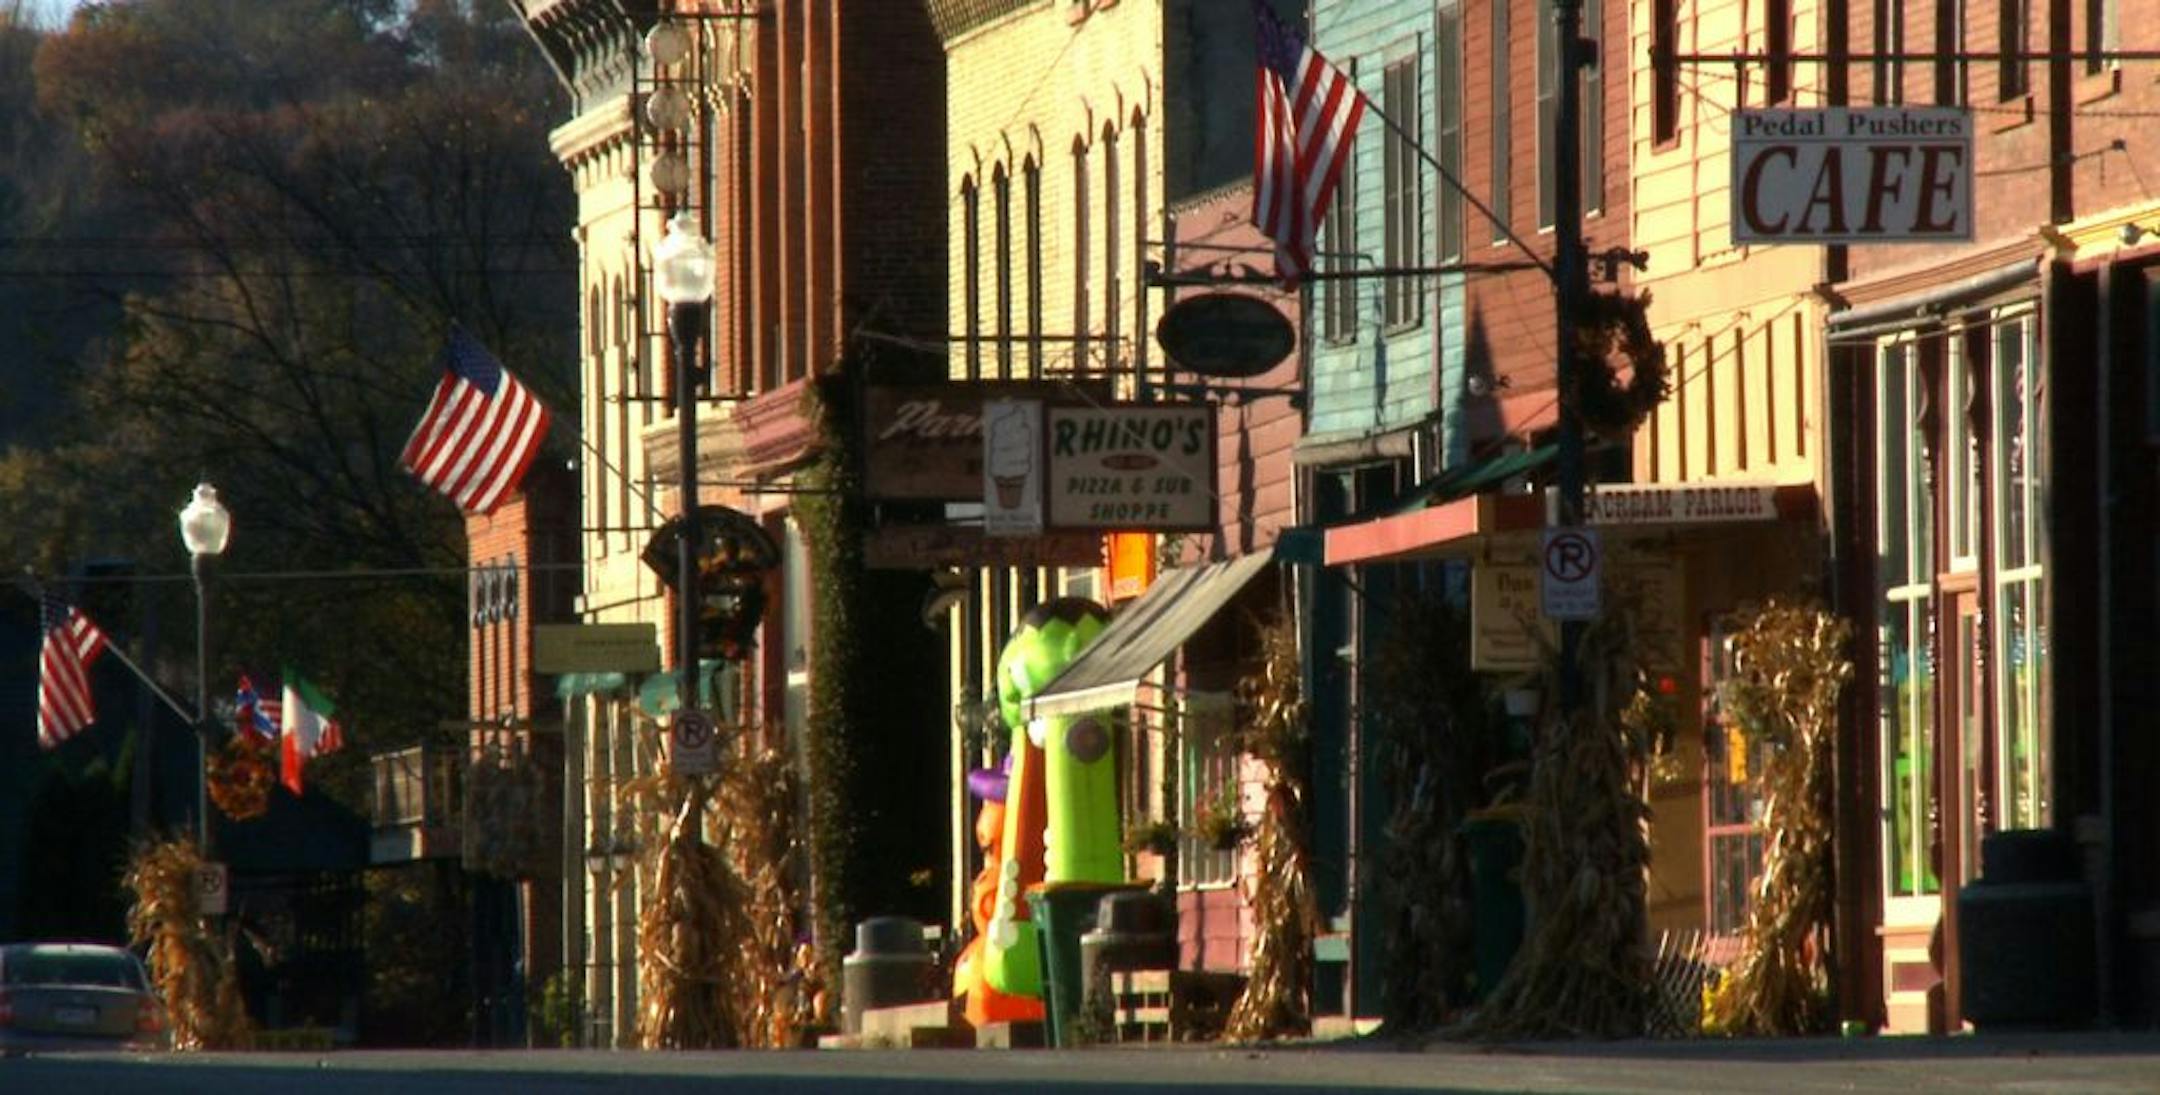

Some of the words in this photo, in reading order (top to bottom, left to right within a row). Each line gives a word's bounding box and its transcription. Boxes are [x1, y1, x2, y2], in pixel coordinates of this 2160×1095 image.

[1743, 112, 1825, 137] Pedal
[1847, 112, 1962, 137] Pushers
[1741, 145, 1963, 235] CAFE
[1054, 417, 1205, 457] RHINO'S
[1066, 477, 1123, 495] PIZZA
[1153, 476, 1194, 495] SUB
[1089, 502, 1171, 521] SHOPPE
[1684, 487, 1763, 516] PARLOR
